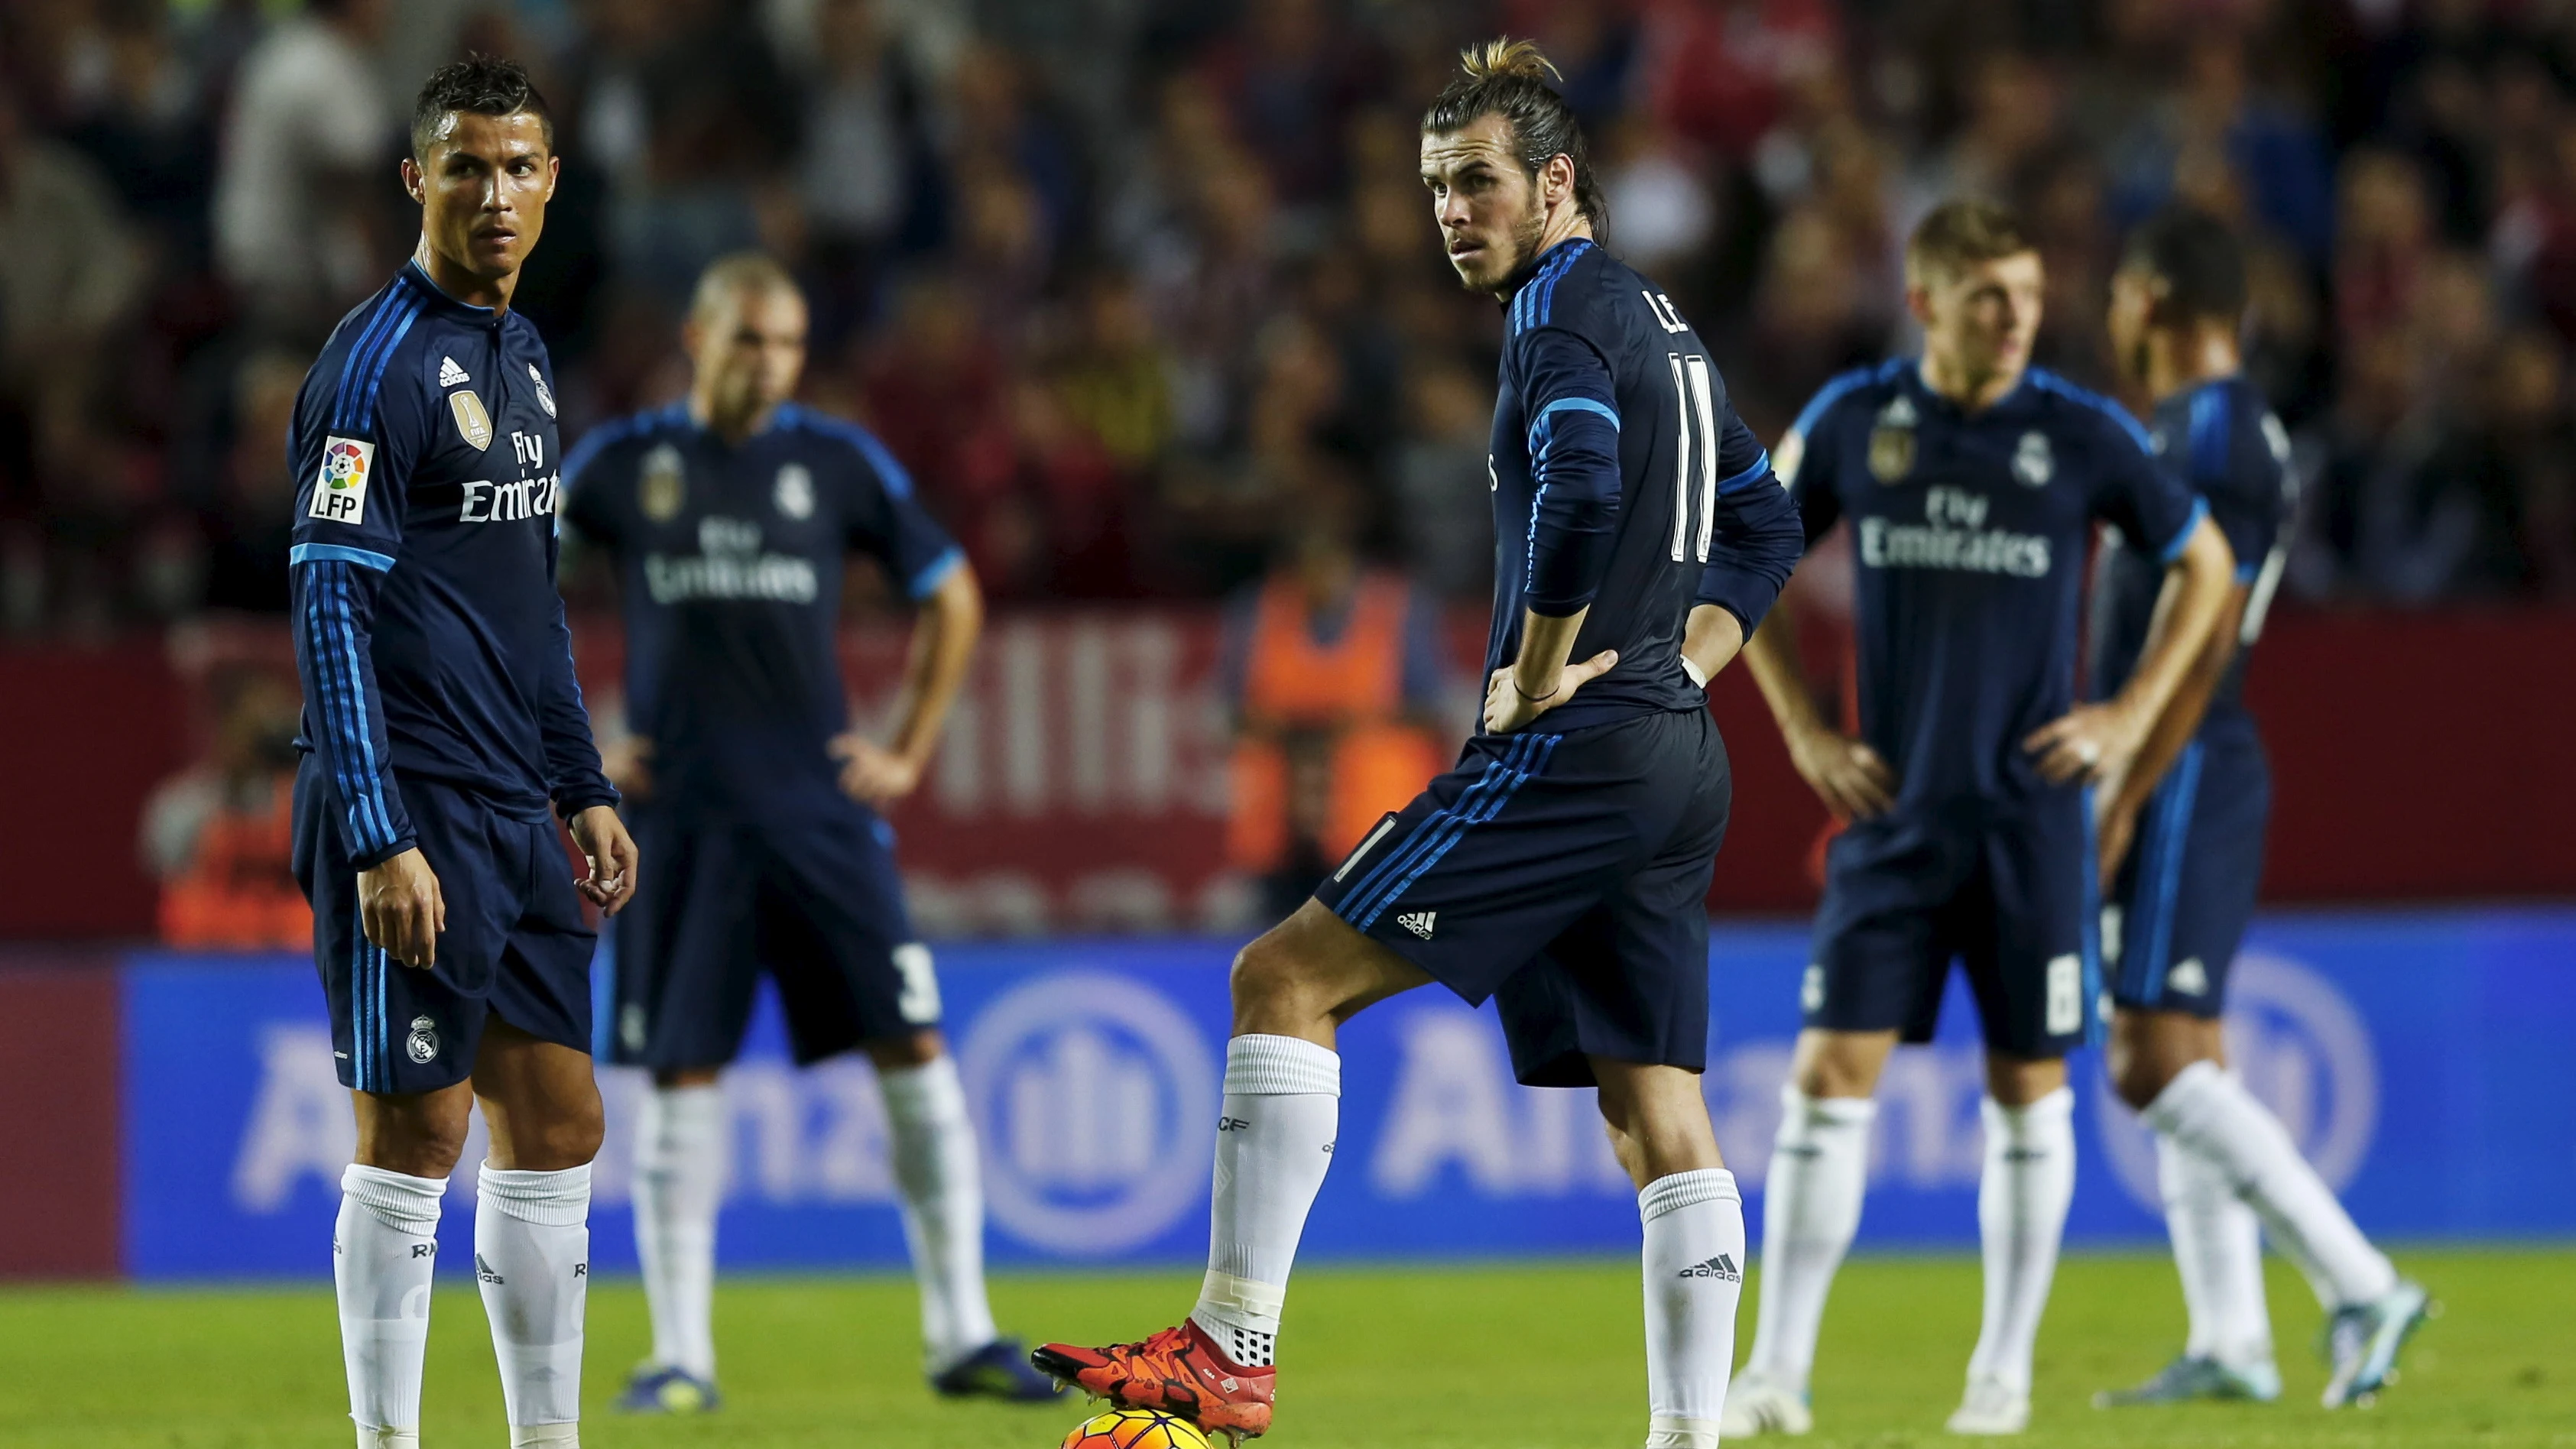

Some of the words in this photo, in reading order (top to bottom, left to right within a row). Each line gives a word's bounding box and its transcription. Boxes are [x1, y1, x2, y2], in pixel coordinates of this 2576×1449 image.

[1642, 290, 1689, 333] LE
[440, 373, 470, 387] adidas
[511, 430, 543, 468] Fly
[1668, 352, 1717, 562] 11
[315, 492, 357, 519] LFP
[1925, 486, 1989, 529] Fly
[1860, 516, 2051, 577] Emirates
[1397, 915, 1433, 940] adidas
[891, 943, 942, 1023] 3
[1679, 1269, 1741, 1283] adidas
